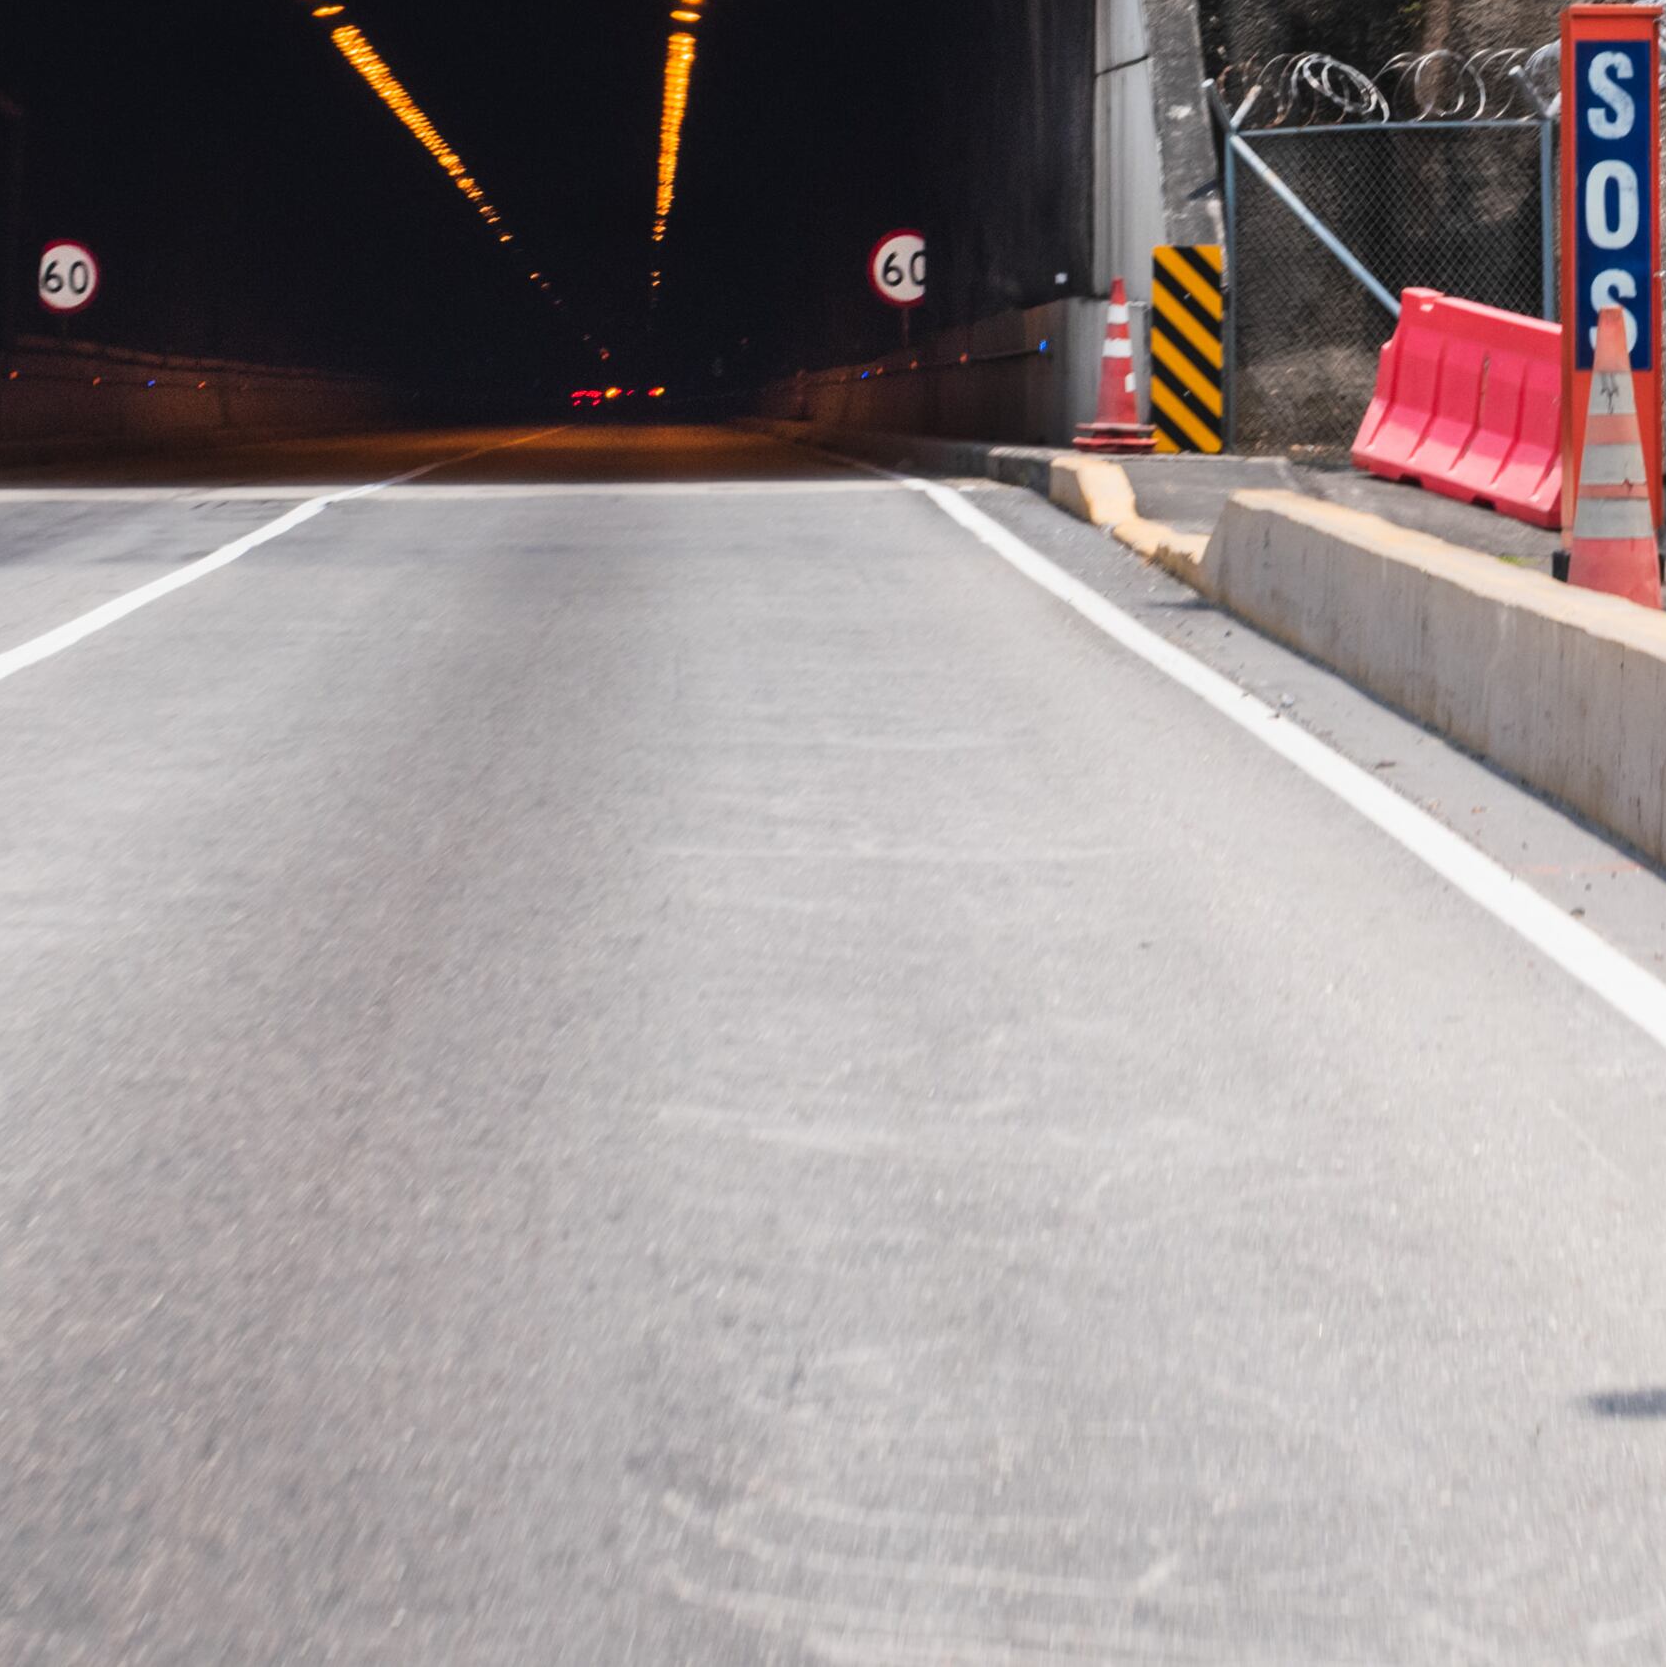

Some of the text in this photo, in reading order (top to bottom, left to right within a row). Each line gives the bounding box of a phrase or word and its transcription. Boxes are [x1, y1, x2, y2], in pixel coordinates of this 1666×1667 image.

[1585, 51, 1639, 355] SOS
[42, 260, 89, 294] 60
[882, 251, 925, 287] 60
